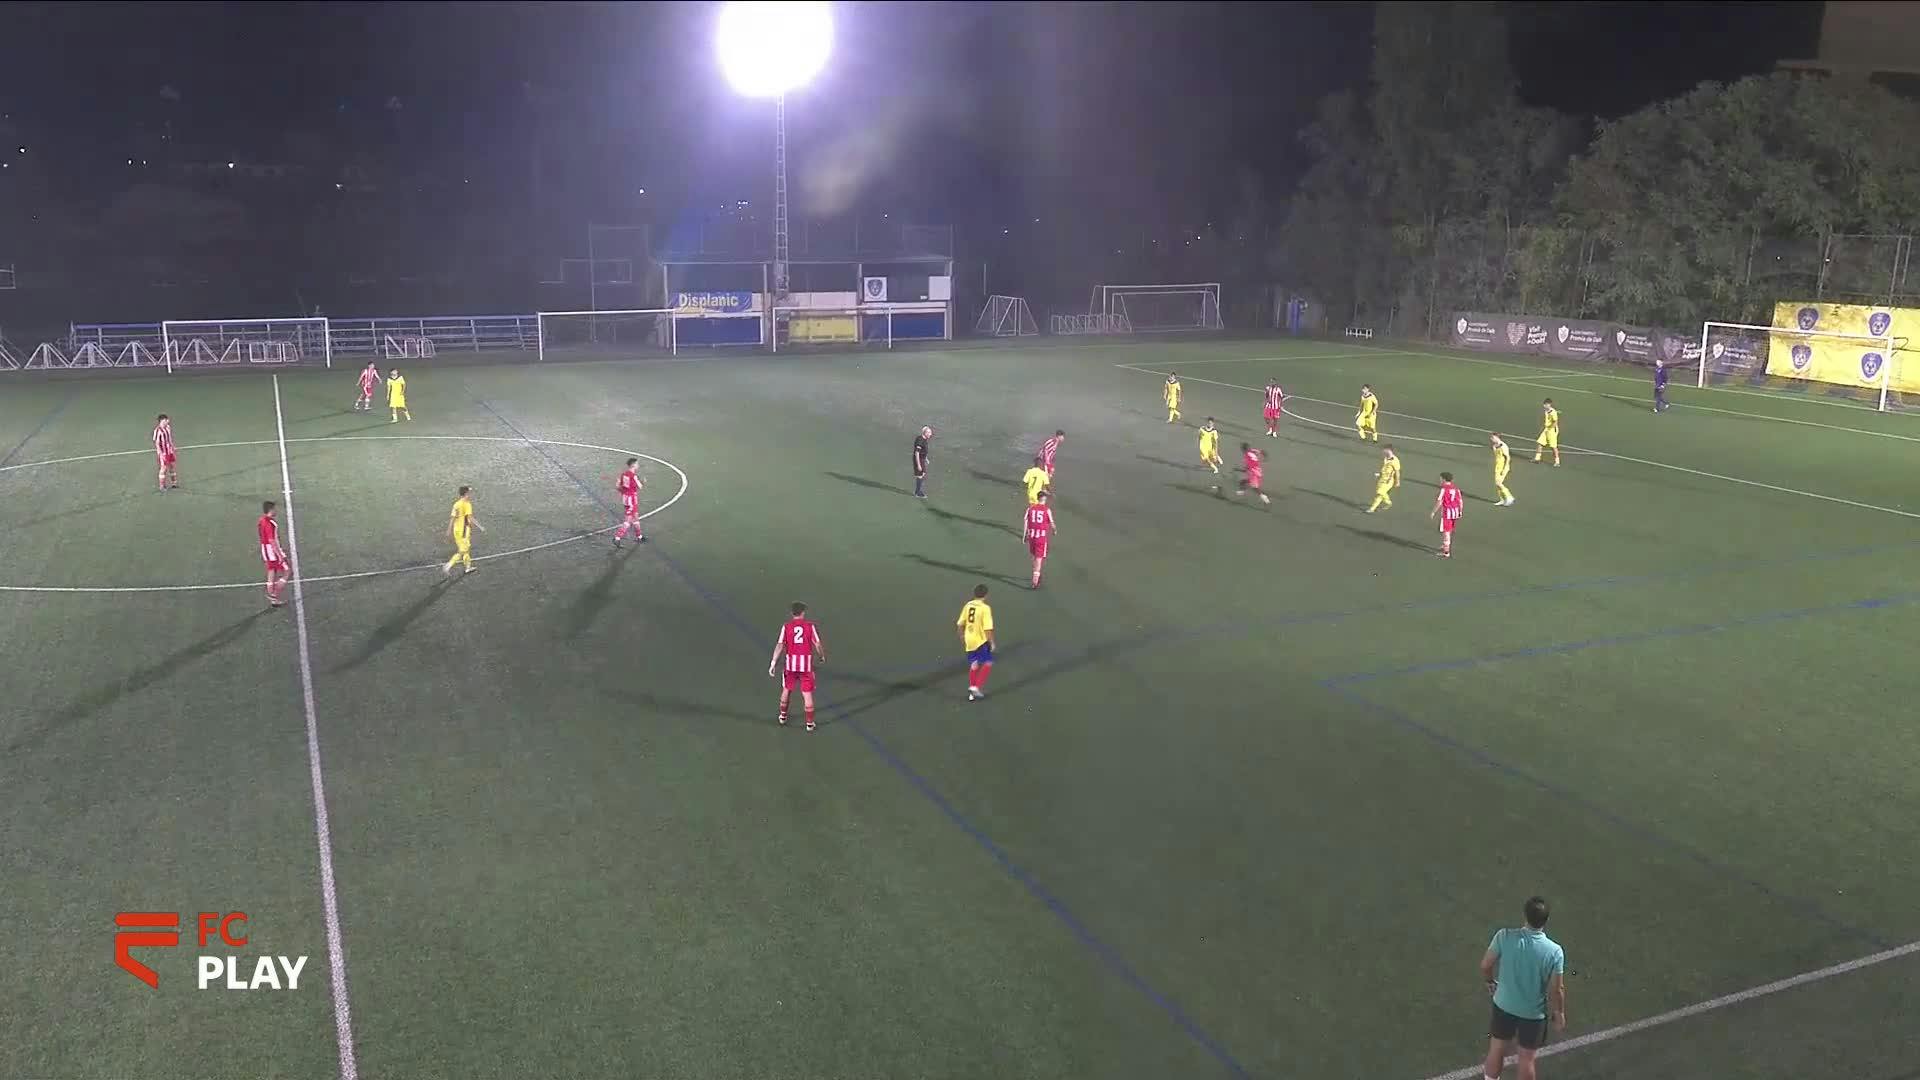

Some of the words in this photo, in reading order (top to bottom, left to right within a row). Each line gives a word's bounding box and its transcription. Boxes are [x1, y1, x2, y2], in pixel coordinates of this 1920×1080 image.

[679, 293, 739, 309] Displanic
[1449, 489, 1456, 501] 7
[1031, 510, 1044, 523] 15
[968, 607, 976, 623] 8
[793, 625, 804, 644] 2
